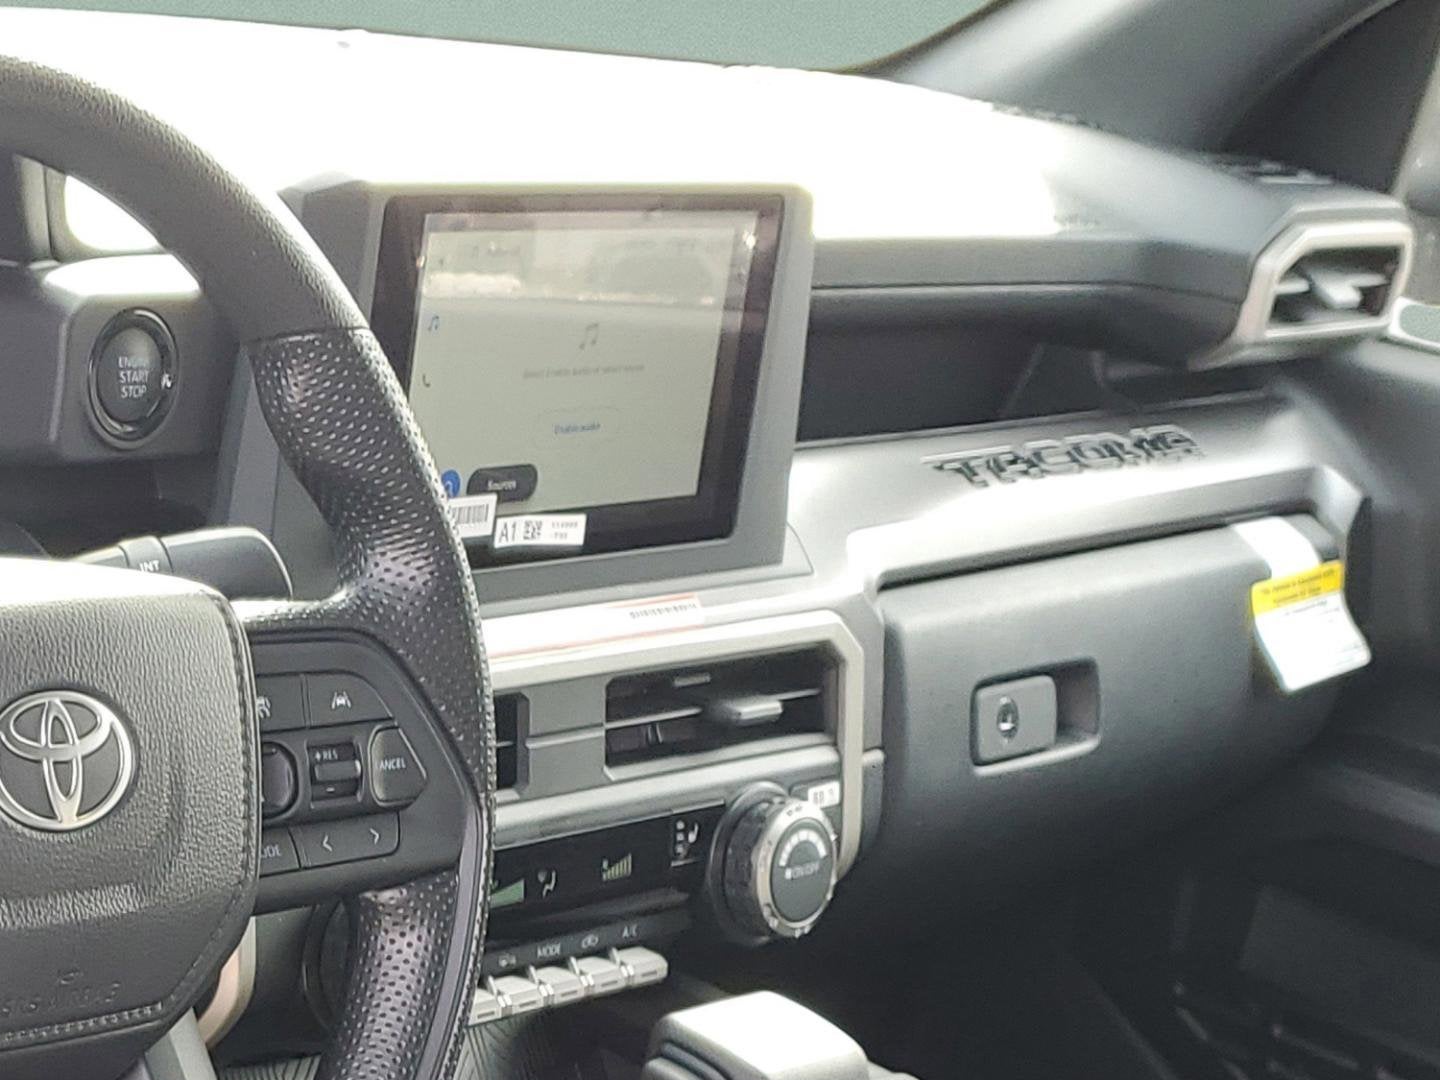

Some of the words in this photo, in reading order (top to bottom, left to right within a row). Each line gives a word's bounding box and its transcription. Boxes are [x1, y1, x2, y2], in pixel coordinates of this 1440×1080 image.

[120, 371, 149, 384] START
[121, 385, 147, 398] STOP
[934, 424, 1206, 488] TACOMA
[498, 521, 517, 544] A1
[536, 942, 561, 959] MODE
